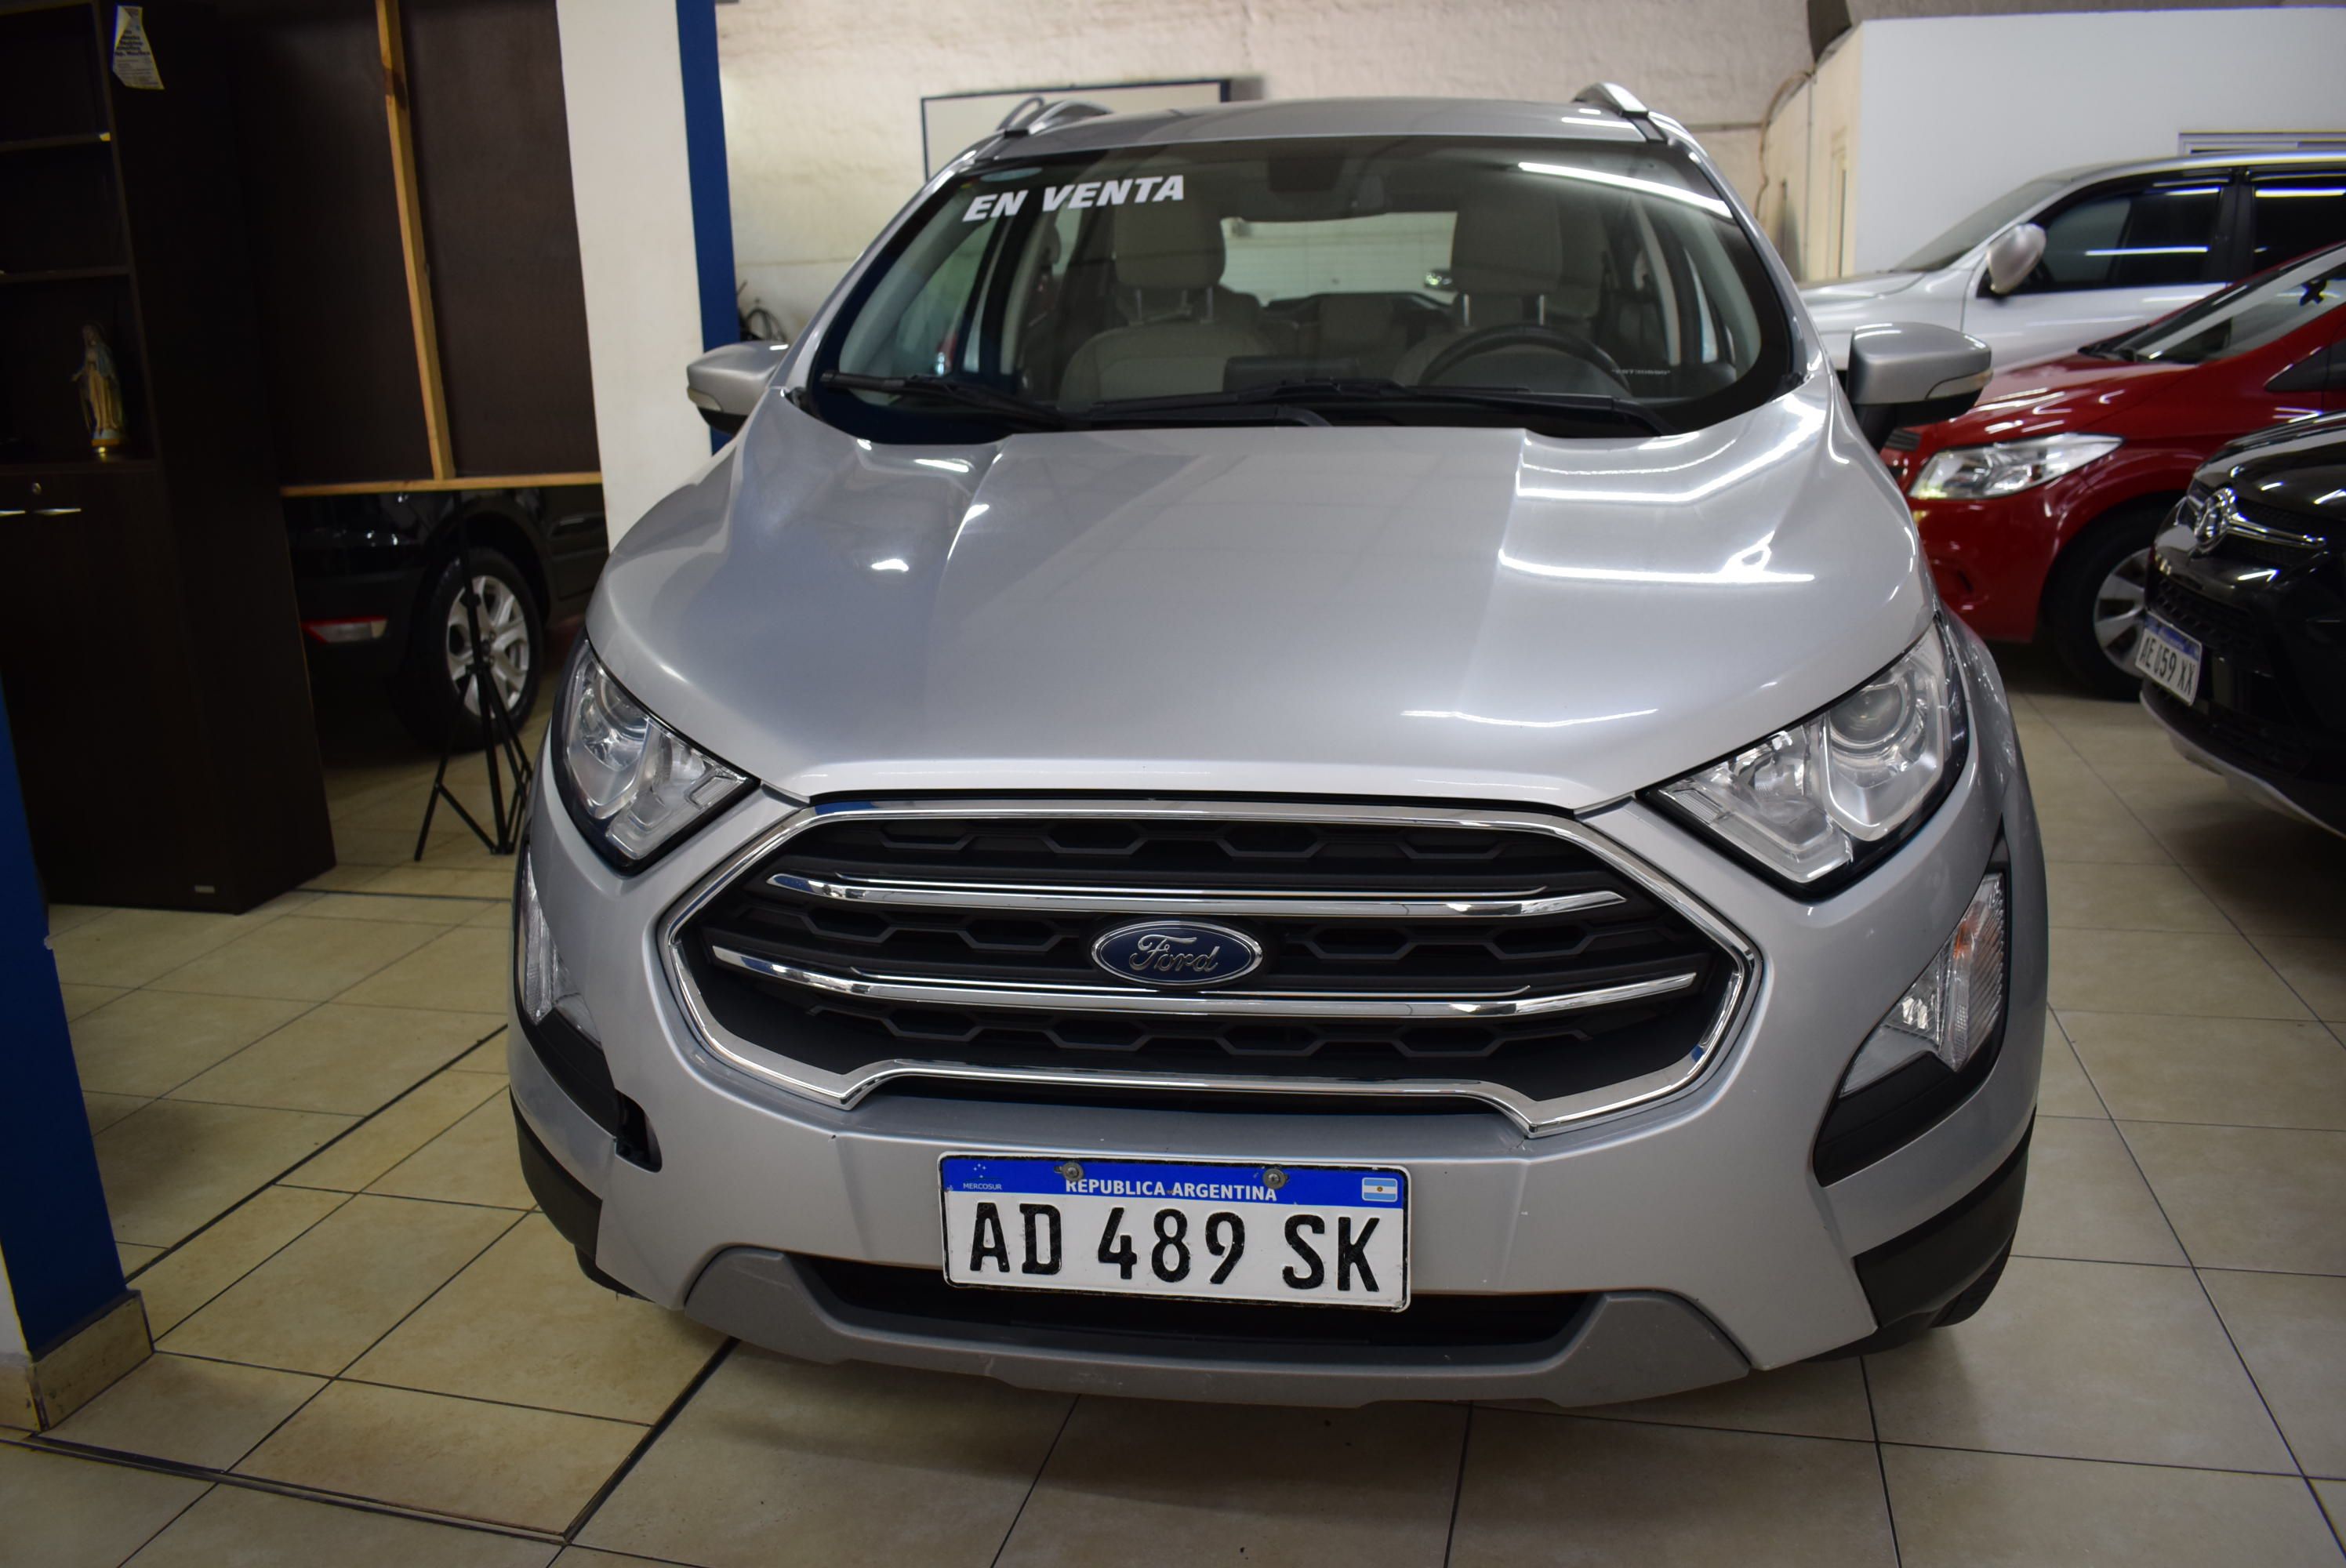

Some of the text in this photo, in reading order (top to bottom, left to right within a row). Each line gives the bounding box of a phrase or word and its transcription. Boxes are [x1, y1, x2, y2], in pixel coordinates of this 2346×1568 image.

[963, 175, 1184, 222] EN VENTA
[2139, 637, 2156, 668] AE
[2177, 659, 2196, 696] XX
[1129, 934, 1220, 972] Ford
[1066, 1178, 1277, 1202] REPUBLICA ARGENTINA
[970, 1202, 1380, 1291] AD 489 SK
